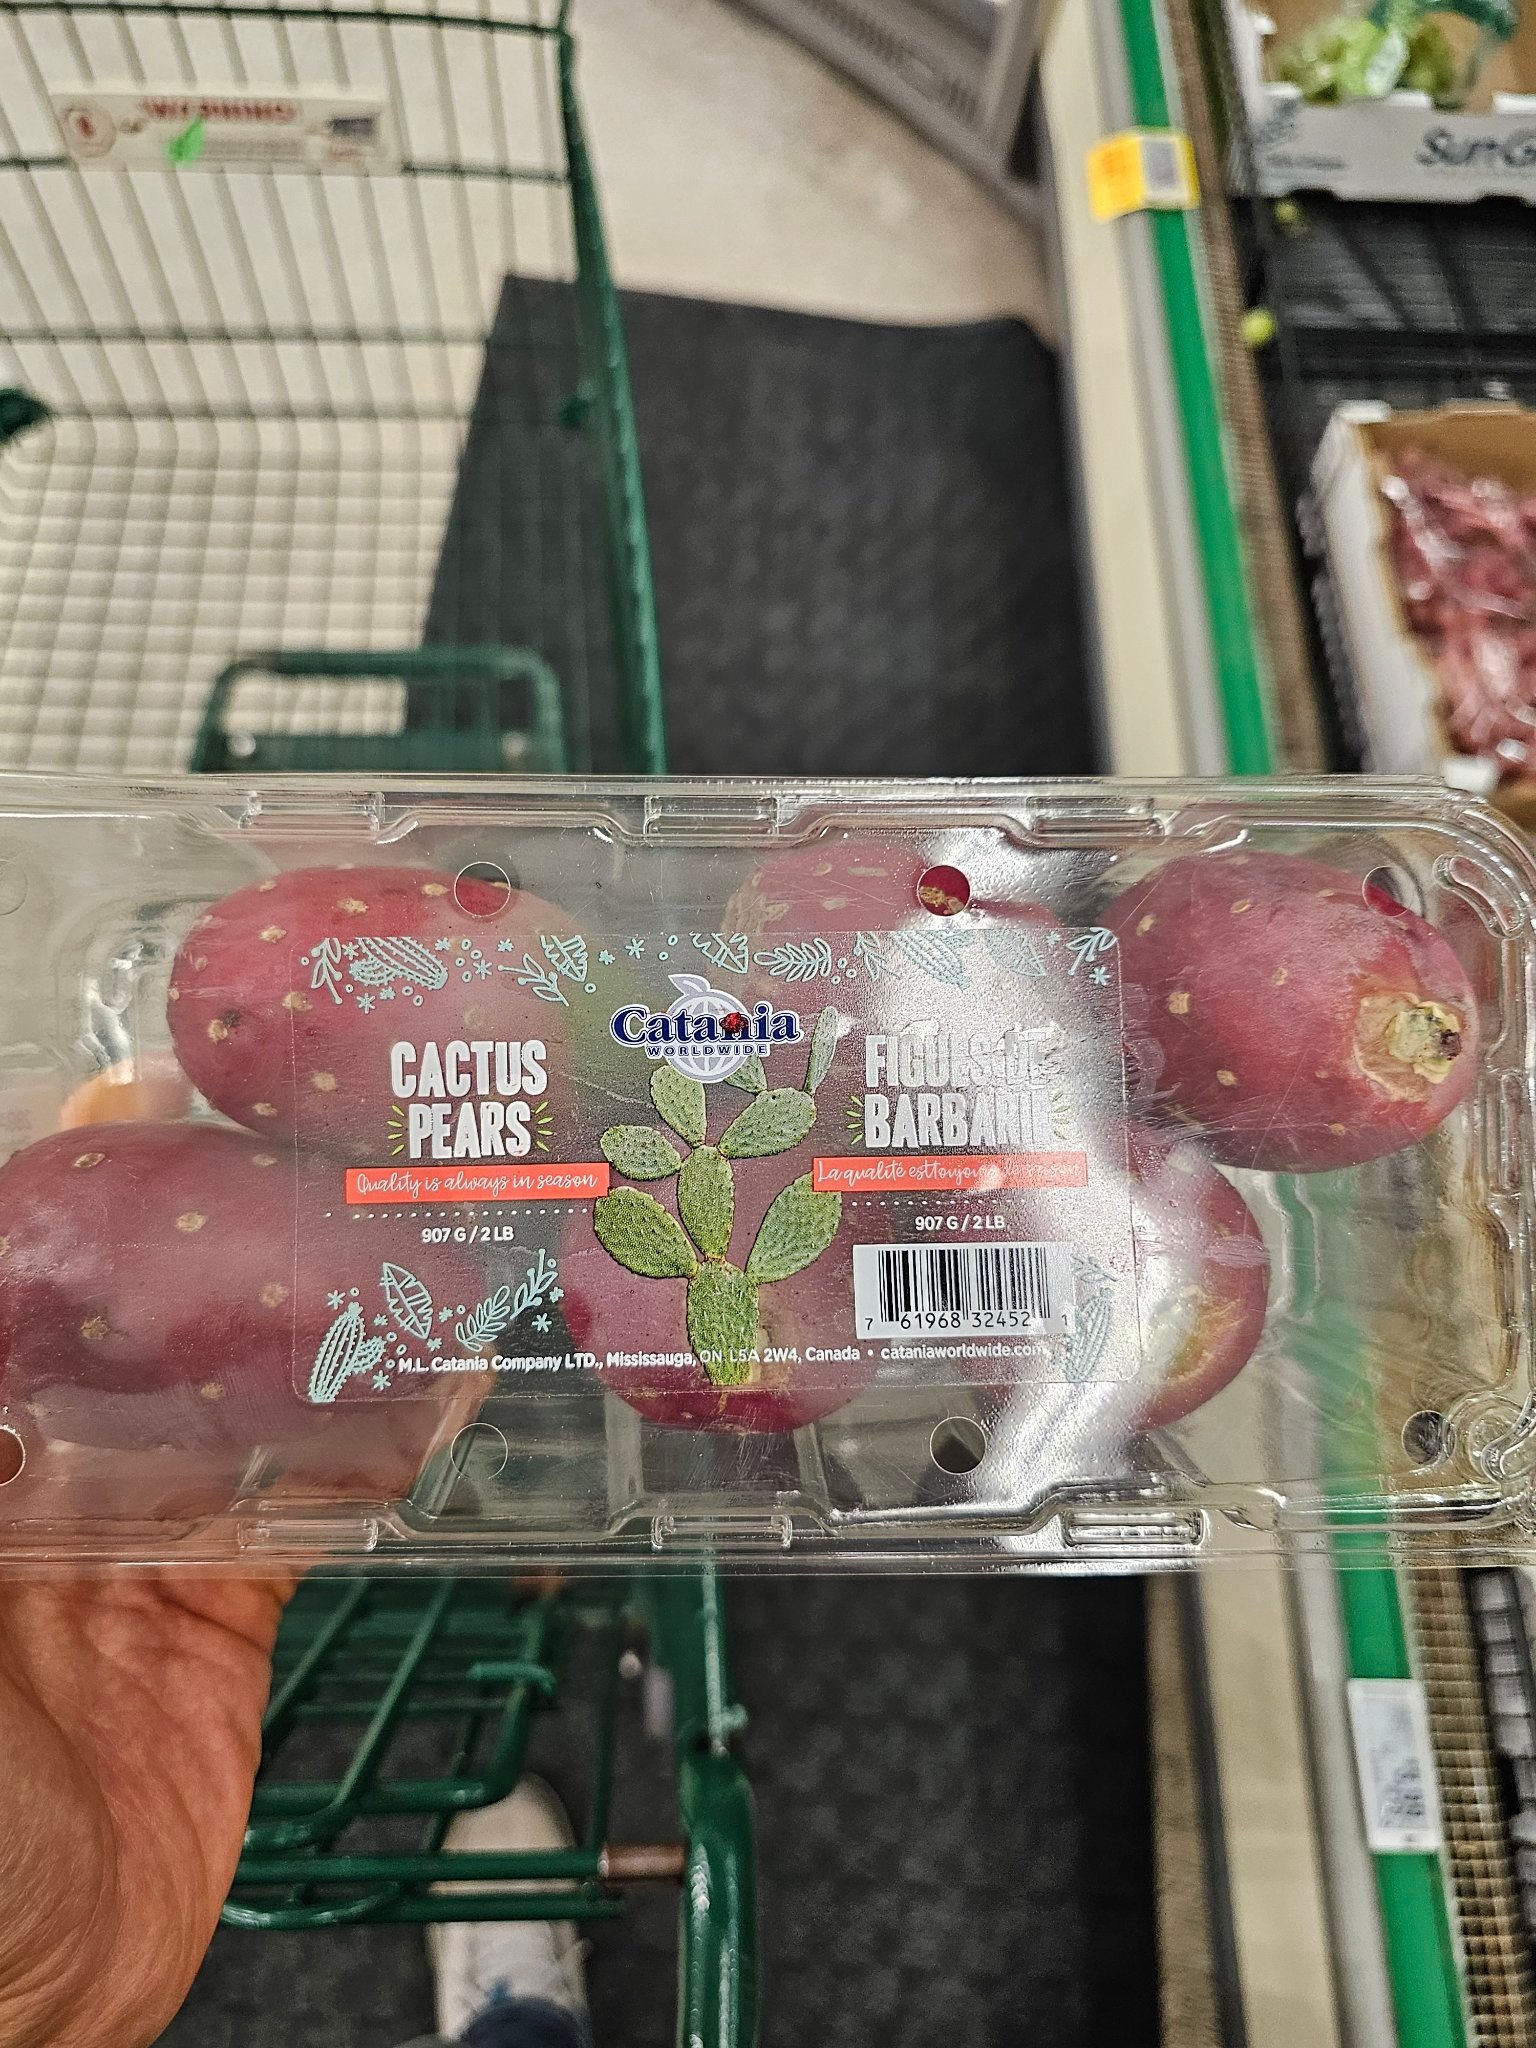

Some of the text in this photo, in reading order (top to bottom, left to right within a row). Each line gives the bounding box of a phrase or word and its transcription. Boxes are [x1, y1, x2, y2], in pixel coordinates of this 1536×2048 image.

[611, 1004, 801, 1044] Catania
[647, 1044, 769, 1057] WORLDWIDE
[390, 1040, 548, 1098] CACTUS
[409, 1101, 531, 1159] PEARS
[357, 1170, 598, 1199] Quality is always in season
[817, 1162, 843, 1182] La
[844, 1160, 904, 1187] qualité
[421, 1228, 449, 1243] 907
[453, 1227, 467, 1242] G
[480, 1226, 492, 1242] 2
[494, 1226, 514, 1241] LB
[915, 1216, 942, 1231] 907
[946, 1215, 959, 1230] G
[972, 1215, 983, 1229] 2
[985, 1215, 1005, 1229] LB
[864, 1317, 874, 1331] 7
[901, 1312, 961, 1329] 61968
[971, 1311, 1032, 1328] 32452
[399, 1343, 1049, 1374] M.L. Catania Company LTD., Mississauga, ON L5A 2W4, Canada cataniaworldwide.com
